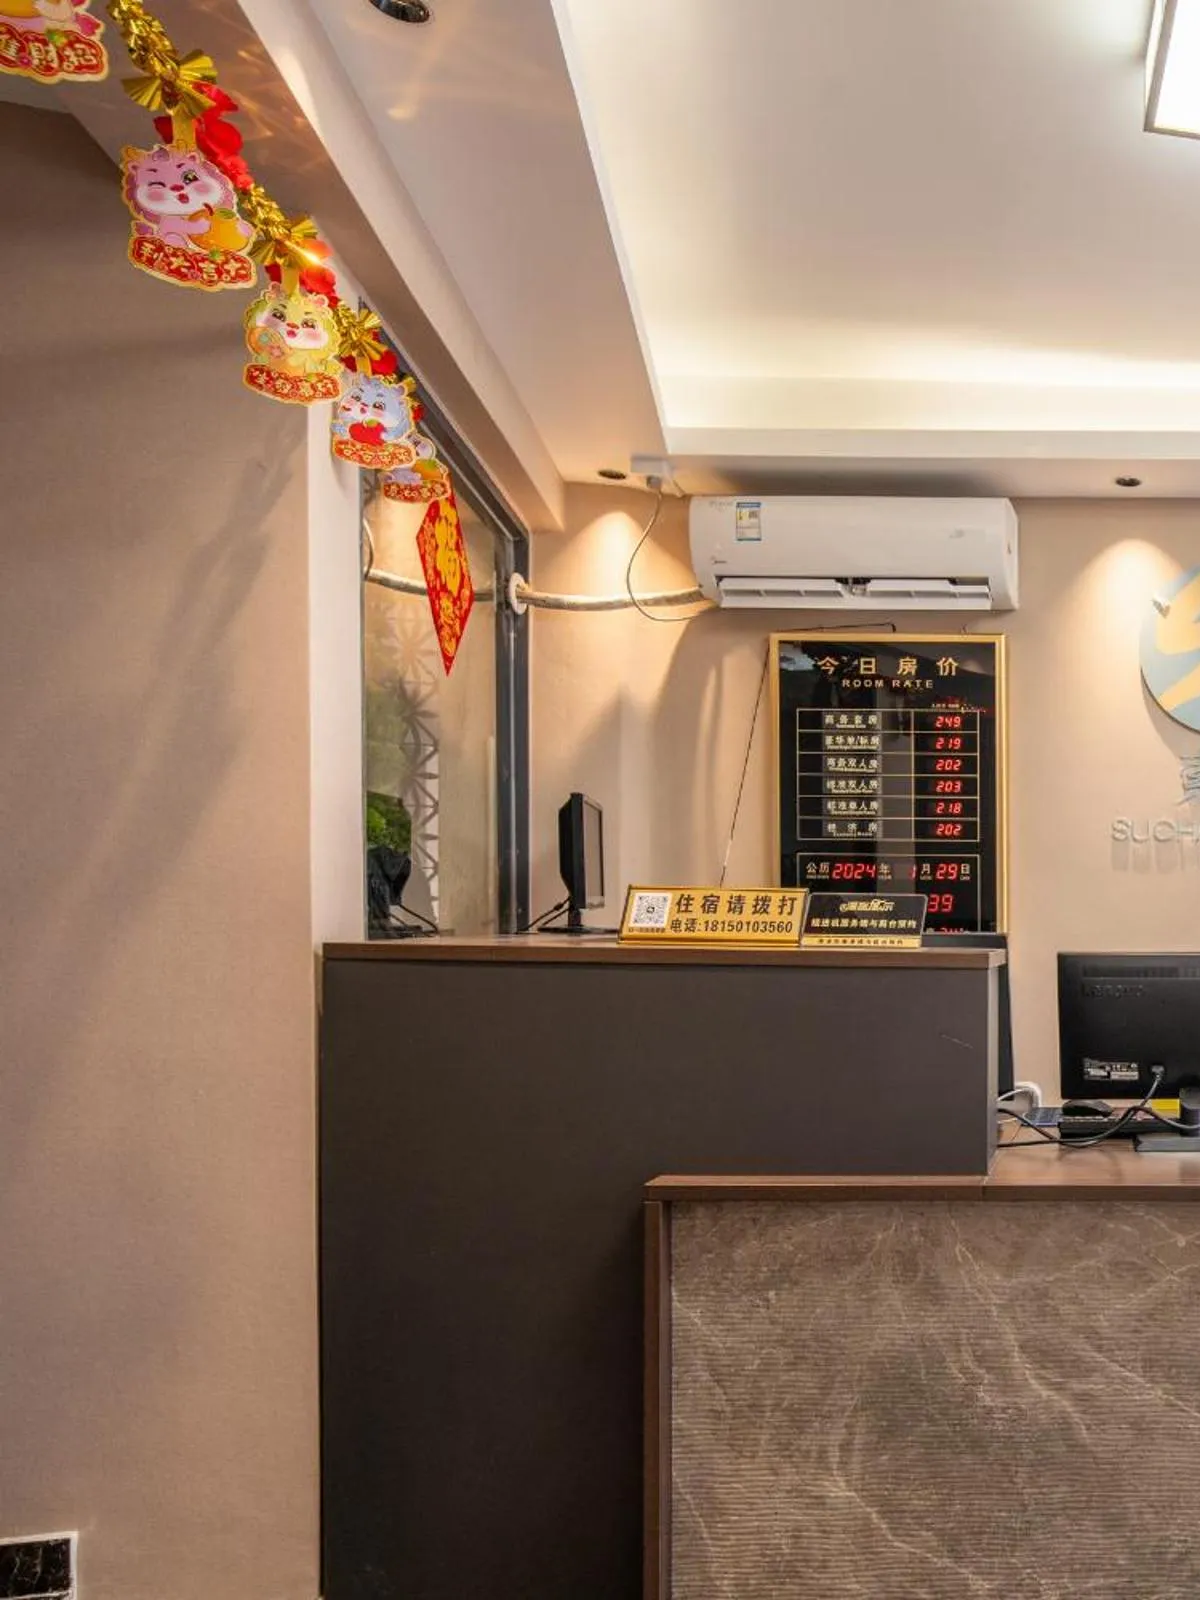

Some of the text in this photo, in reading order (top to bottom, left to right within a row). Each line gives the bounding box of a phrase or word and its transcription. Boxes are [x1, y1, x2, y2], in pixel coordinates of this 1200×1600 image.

[817, 656, 959, 677] 今日房价
[842, 679, 934, 689] ROOM RATE
[935, 716, 961, 728] 249
[935, 737, 961, 749] 219
[935, 759, 961, 771] 202
[935, 781, 961, 793] 203
[935, 802, 961, 814] 218
[935, 824, 961, 836] 202
[806, 862, 830, 873] 公历
[832, 863, 876, 879] 2024
[879, 862, 891, 874] 年
[921, 863, 931, 874] 月
[936, 863, 958, 879] 29
[961, 863, 971, 874] 日
[675, 893, 798, 915] 住宿请拨打
[928, 894, 954, 912] 39
